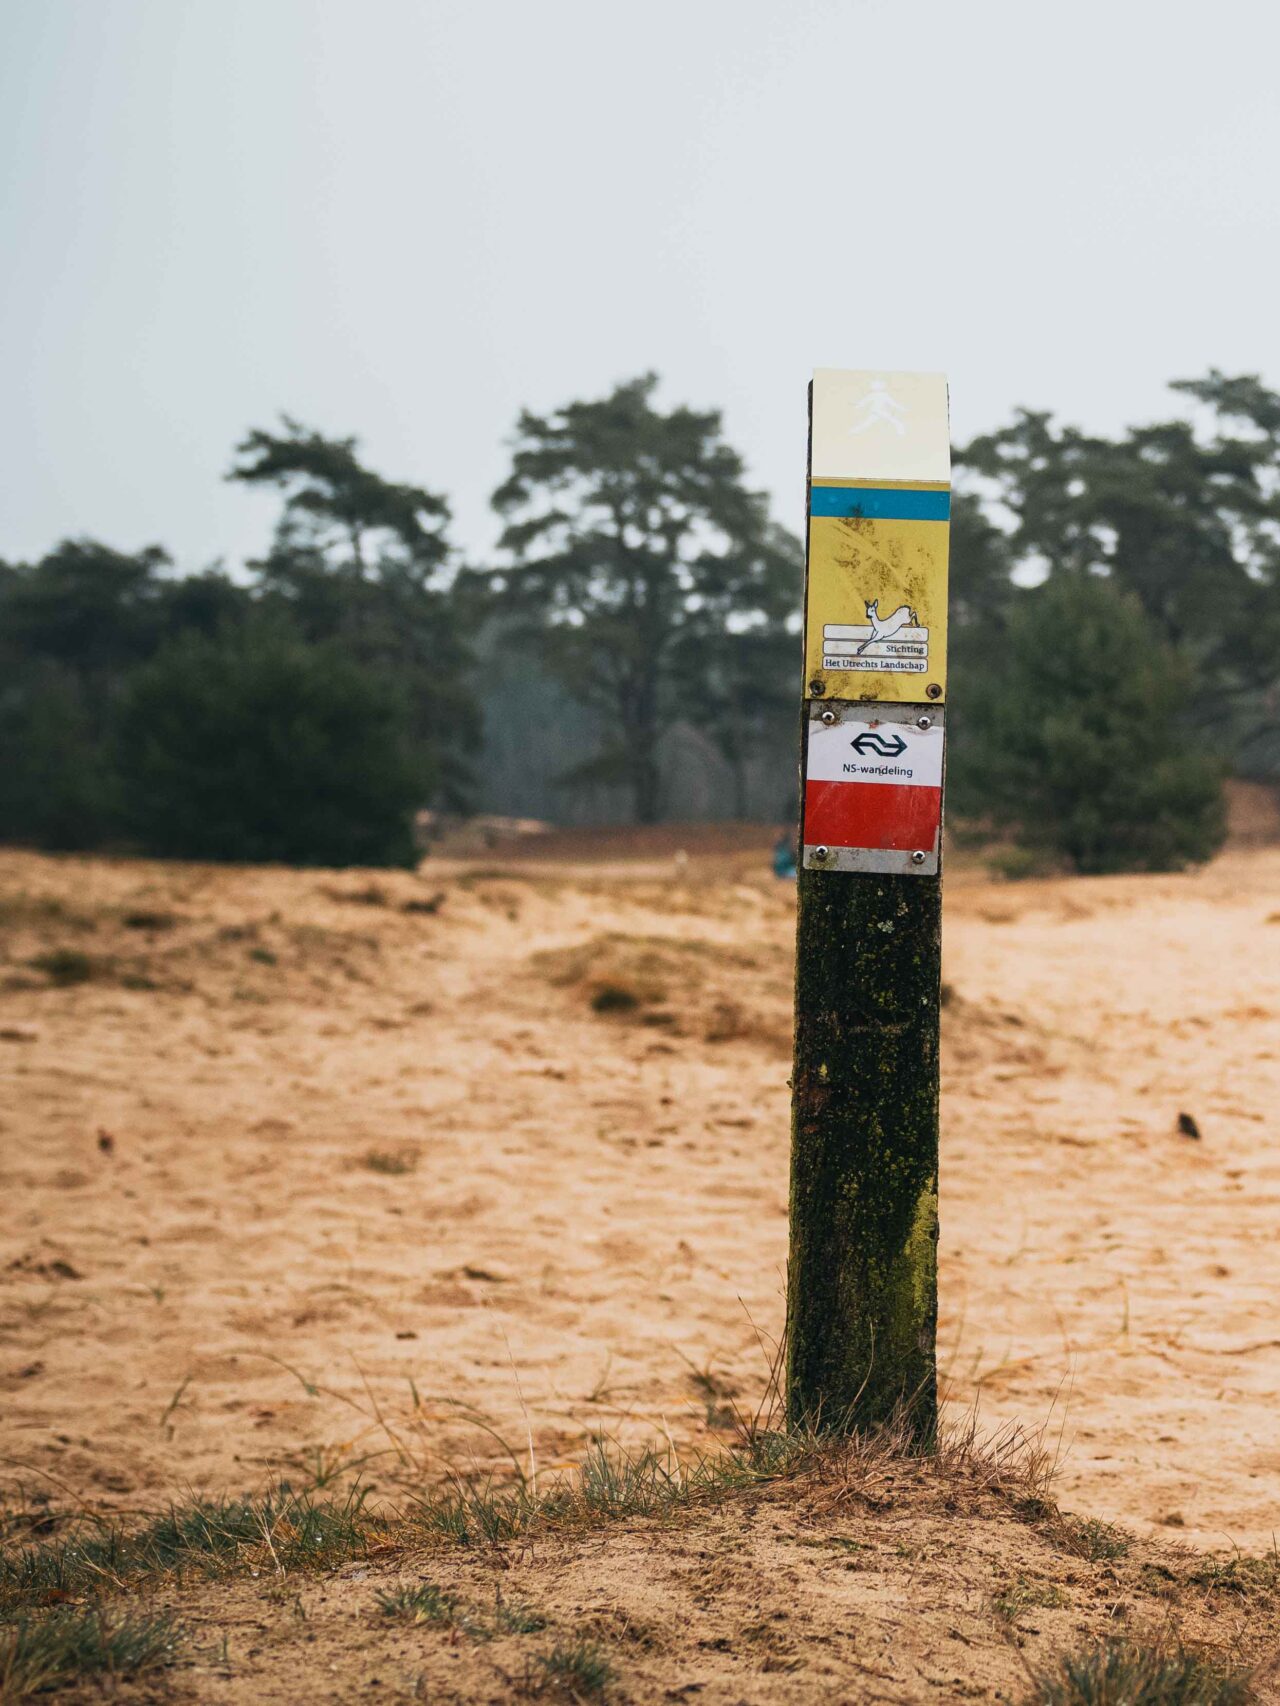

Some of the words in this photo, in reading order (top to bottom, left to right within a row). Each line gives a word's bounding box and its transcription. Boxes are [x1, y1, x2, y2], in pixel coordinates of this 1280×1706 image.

[886, 644, 924, 655] Stichting
[825, 659, 840, 667] Het
[842, 659, 878, 668] Utrechts
[880, 661, 925, 671] Landschap
[842, 764, 913, 778] NS-wandeling
